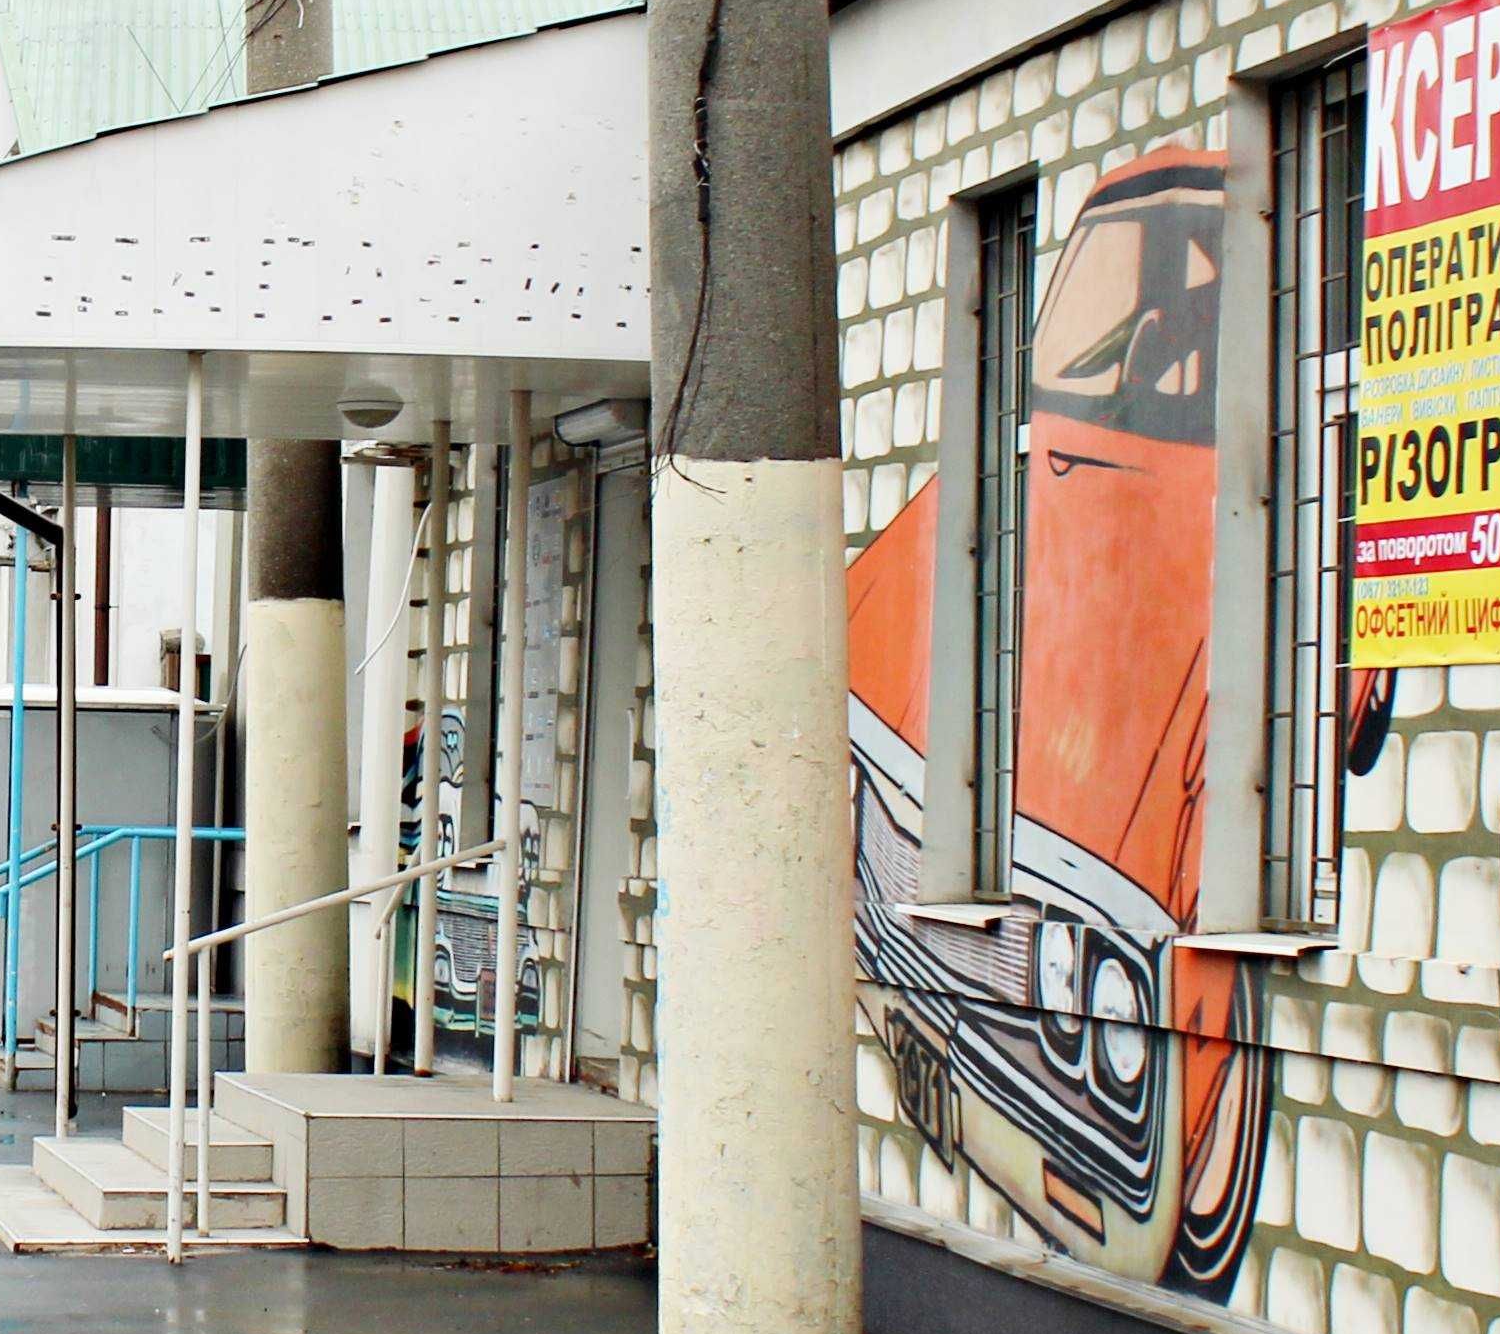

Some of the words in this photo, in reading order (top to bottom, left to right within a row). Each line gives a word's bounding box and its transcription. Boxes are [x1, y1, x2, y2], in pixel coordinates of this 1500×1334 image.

[1356, 540, 1376, 564] за
[1378, 529, 1468, 565] поворотом
[1356, 591, 1450, 639] ОФСЕТНИЙ
[1454, 599, 1461, 635] І
